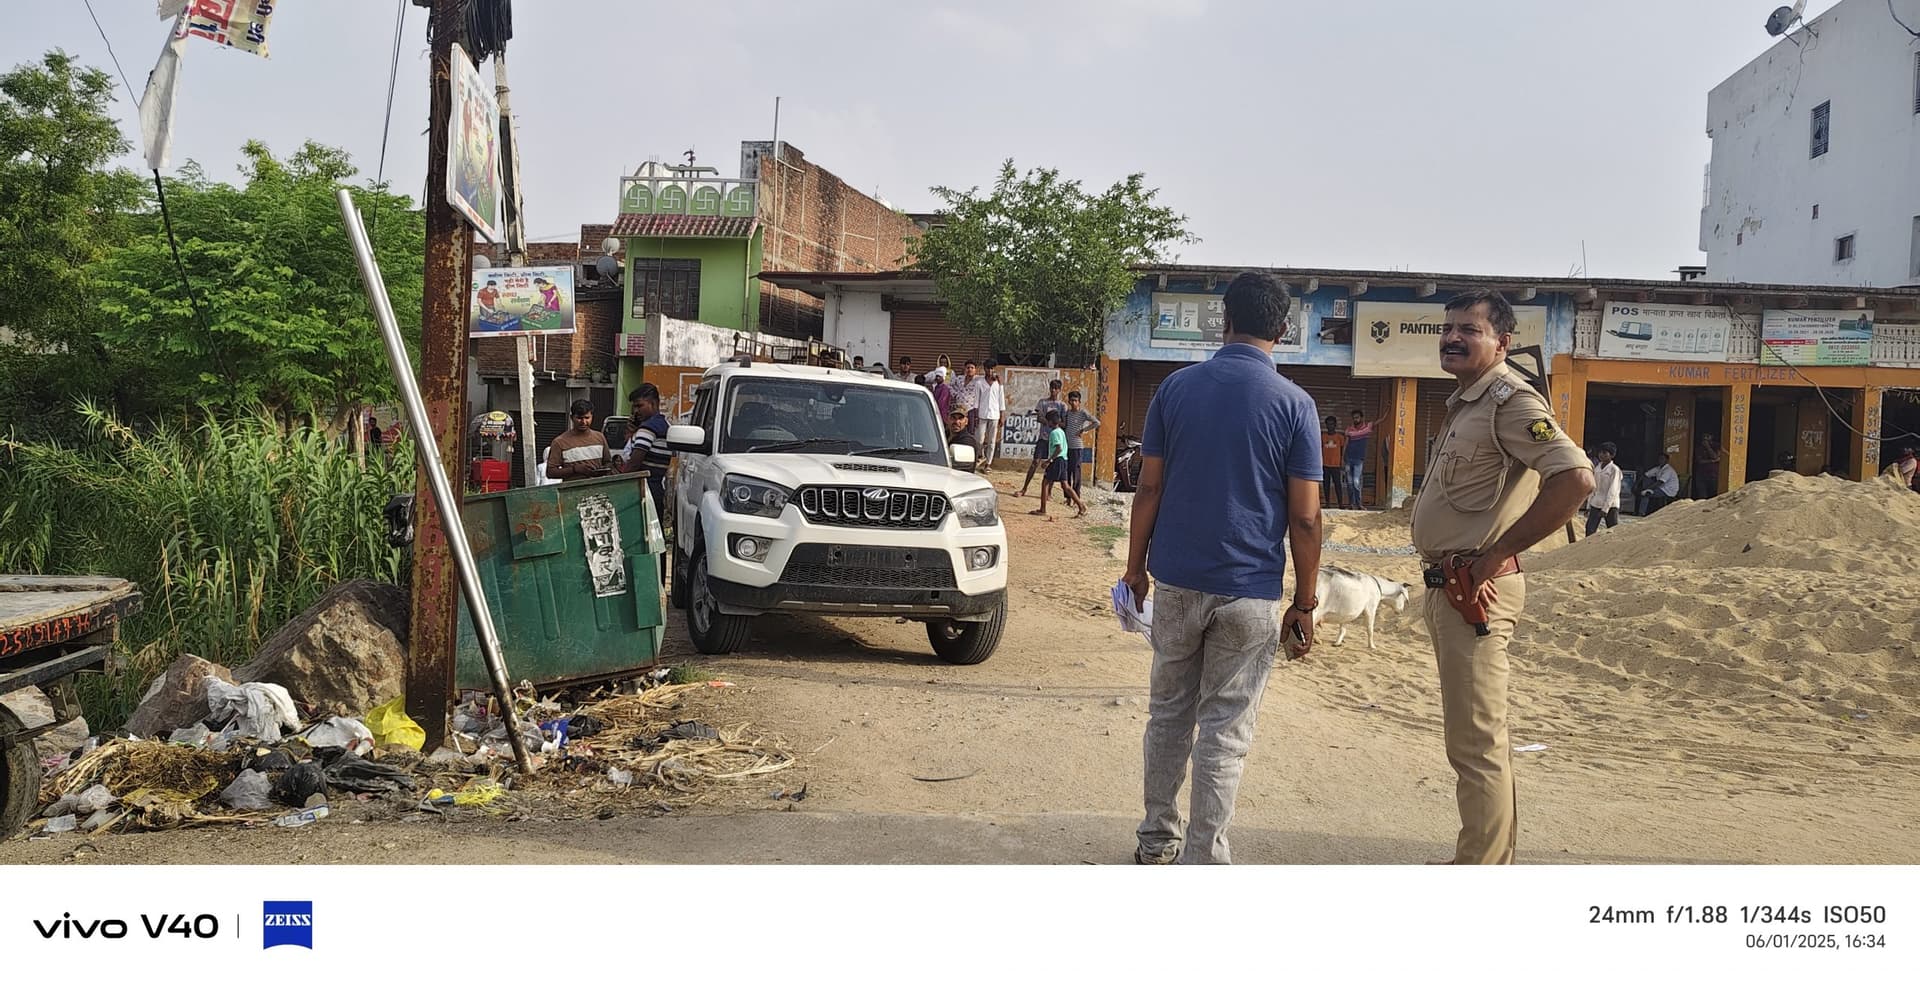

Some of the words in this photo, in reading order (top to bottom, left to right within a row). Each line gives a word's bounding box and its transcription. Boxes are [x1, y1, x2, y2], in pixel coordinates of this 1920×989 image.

[1612, 306, 1639, 316] POS
[1400, 322, 1444, 335] PANTHE
[1669, 366, 1710, 379] KUMAR
[1724, 367, 1797, 380] FERTILIZER
